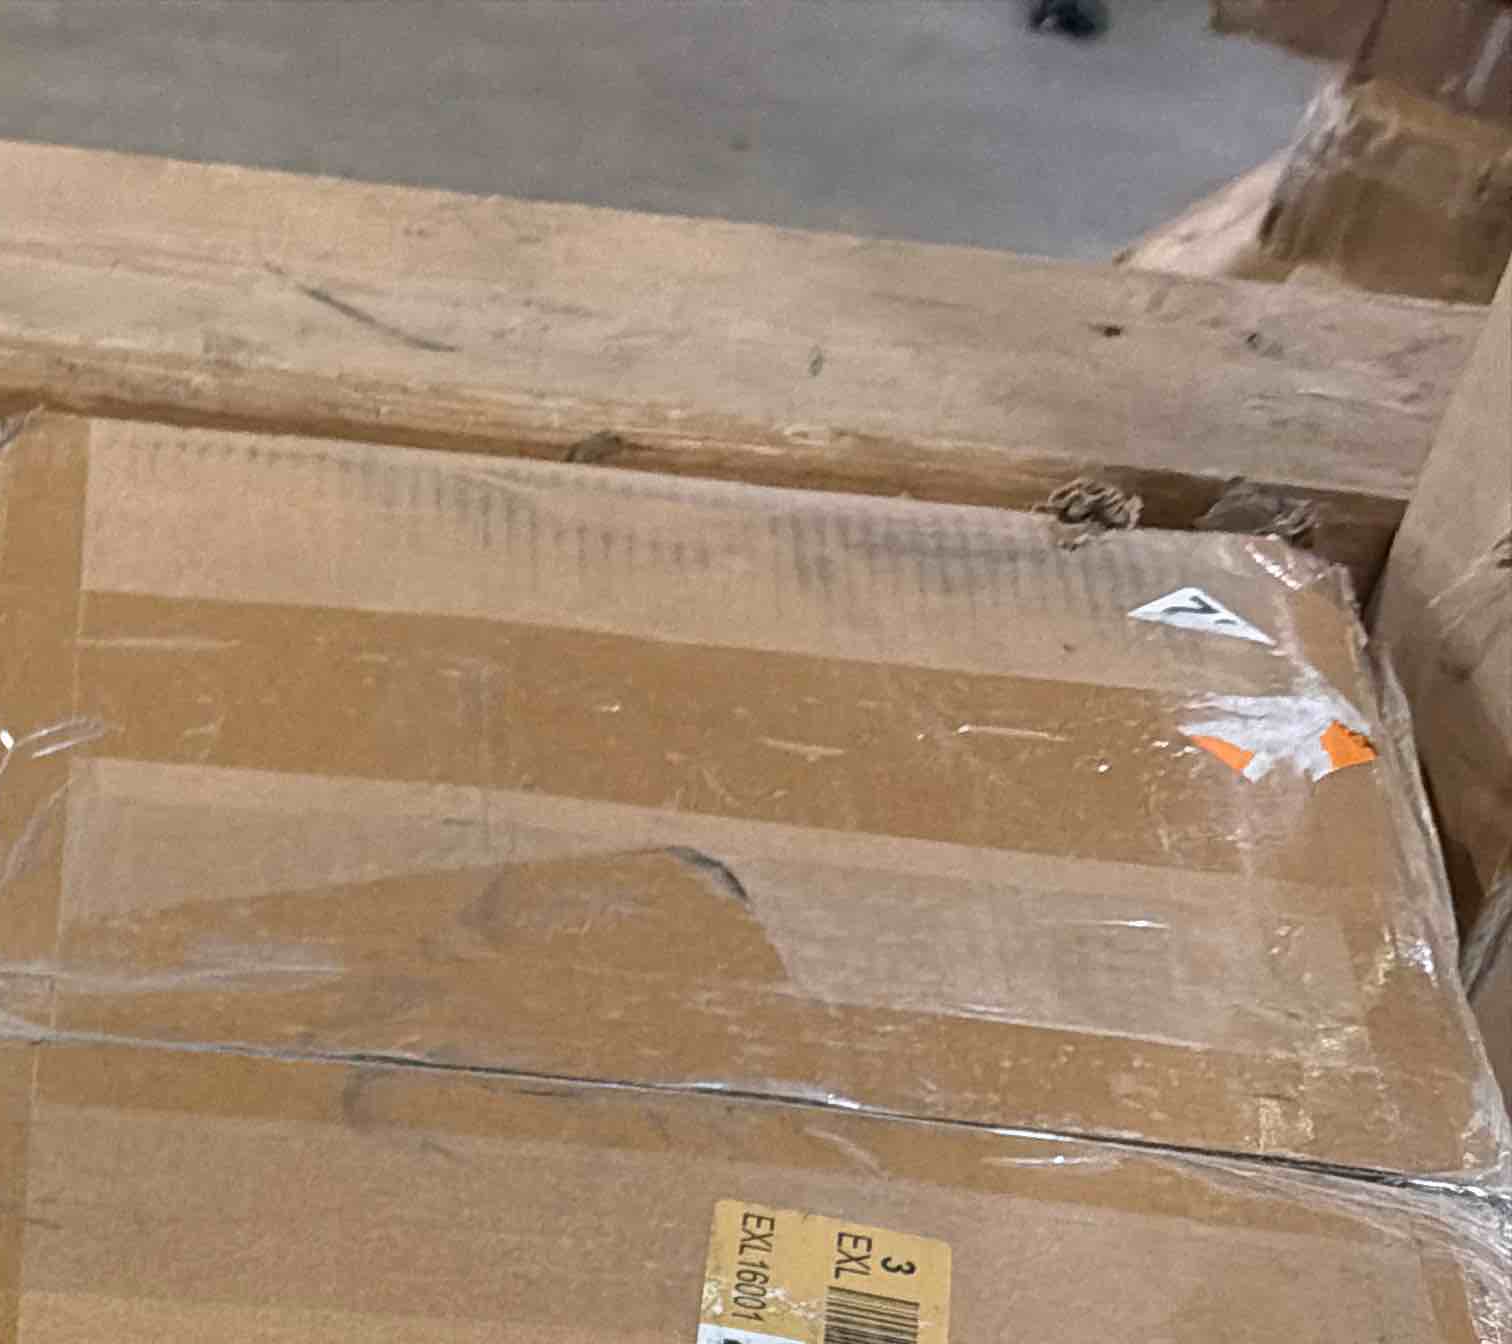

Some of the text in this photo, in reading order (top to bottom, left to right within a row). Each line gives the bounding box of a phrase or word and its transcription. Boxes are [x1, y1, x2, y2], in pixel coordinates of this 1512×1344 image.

[731, 1211, 776, 1323] EXL16001
[834, 1231, 873, 1280] EXL
[880, 1256, 917, 1276] 3
